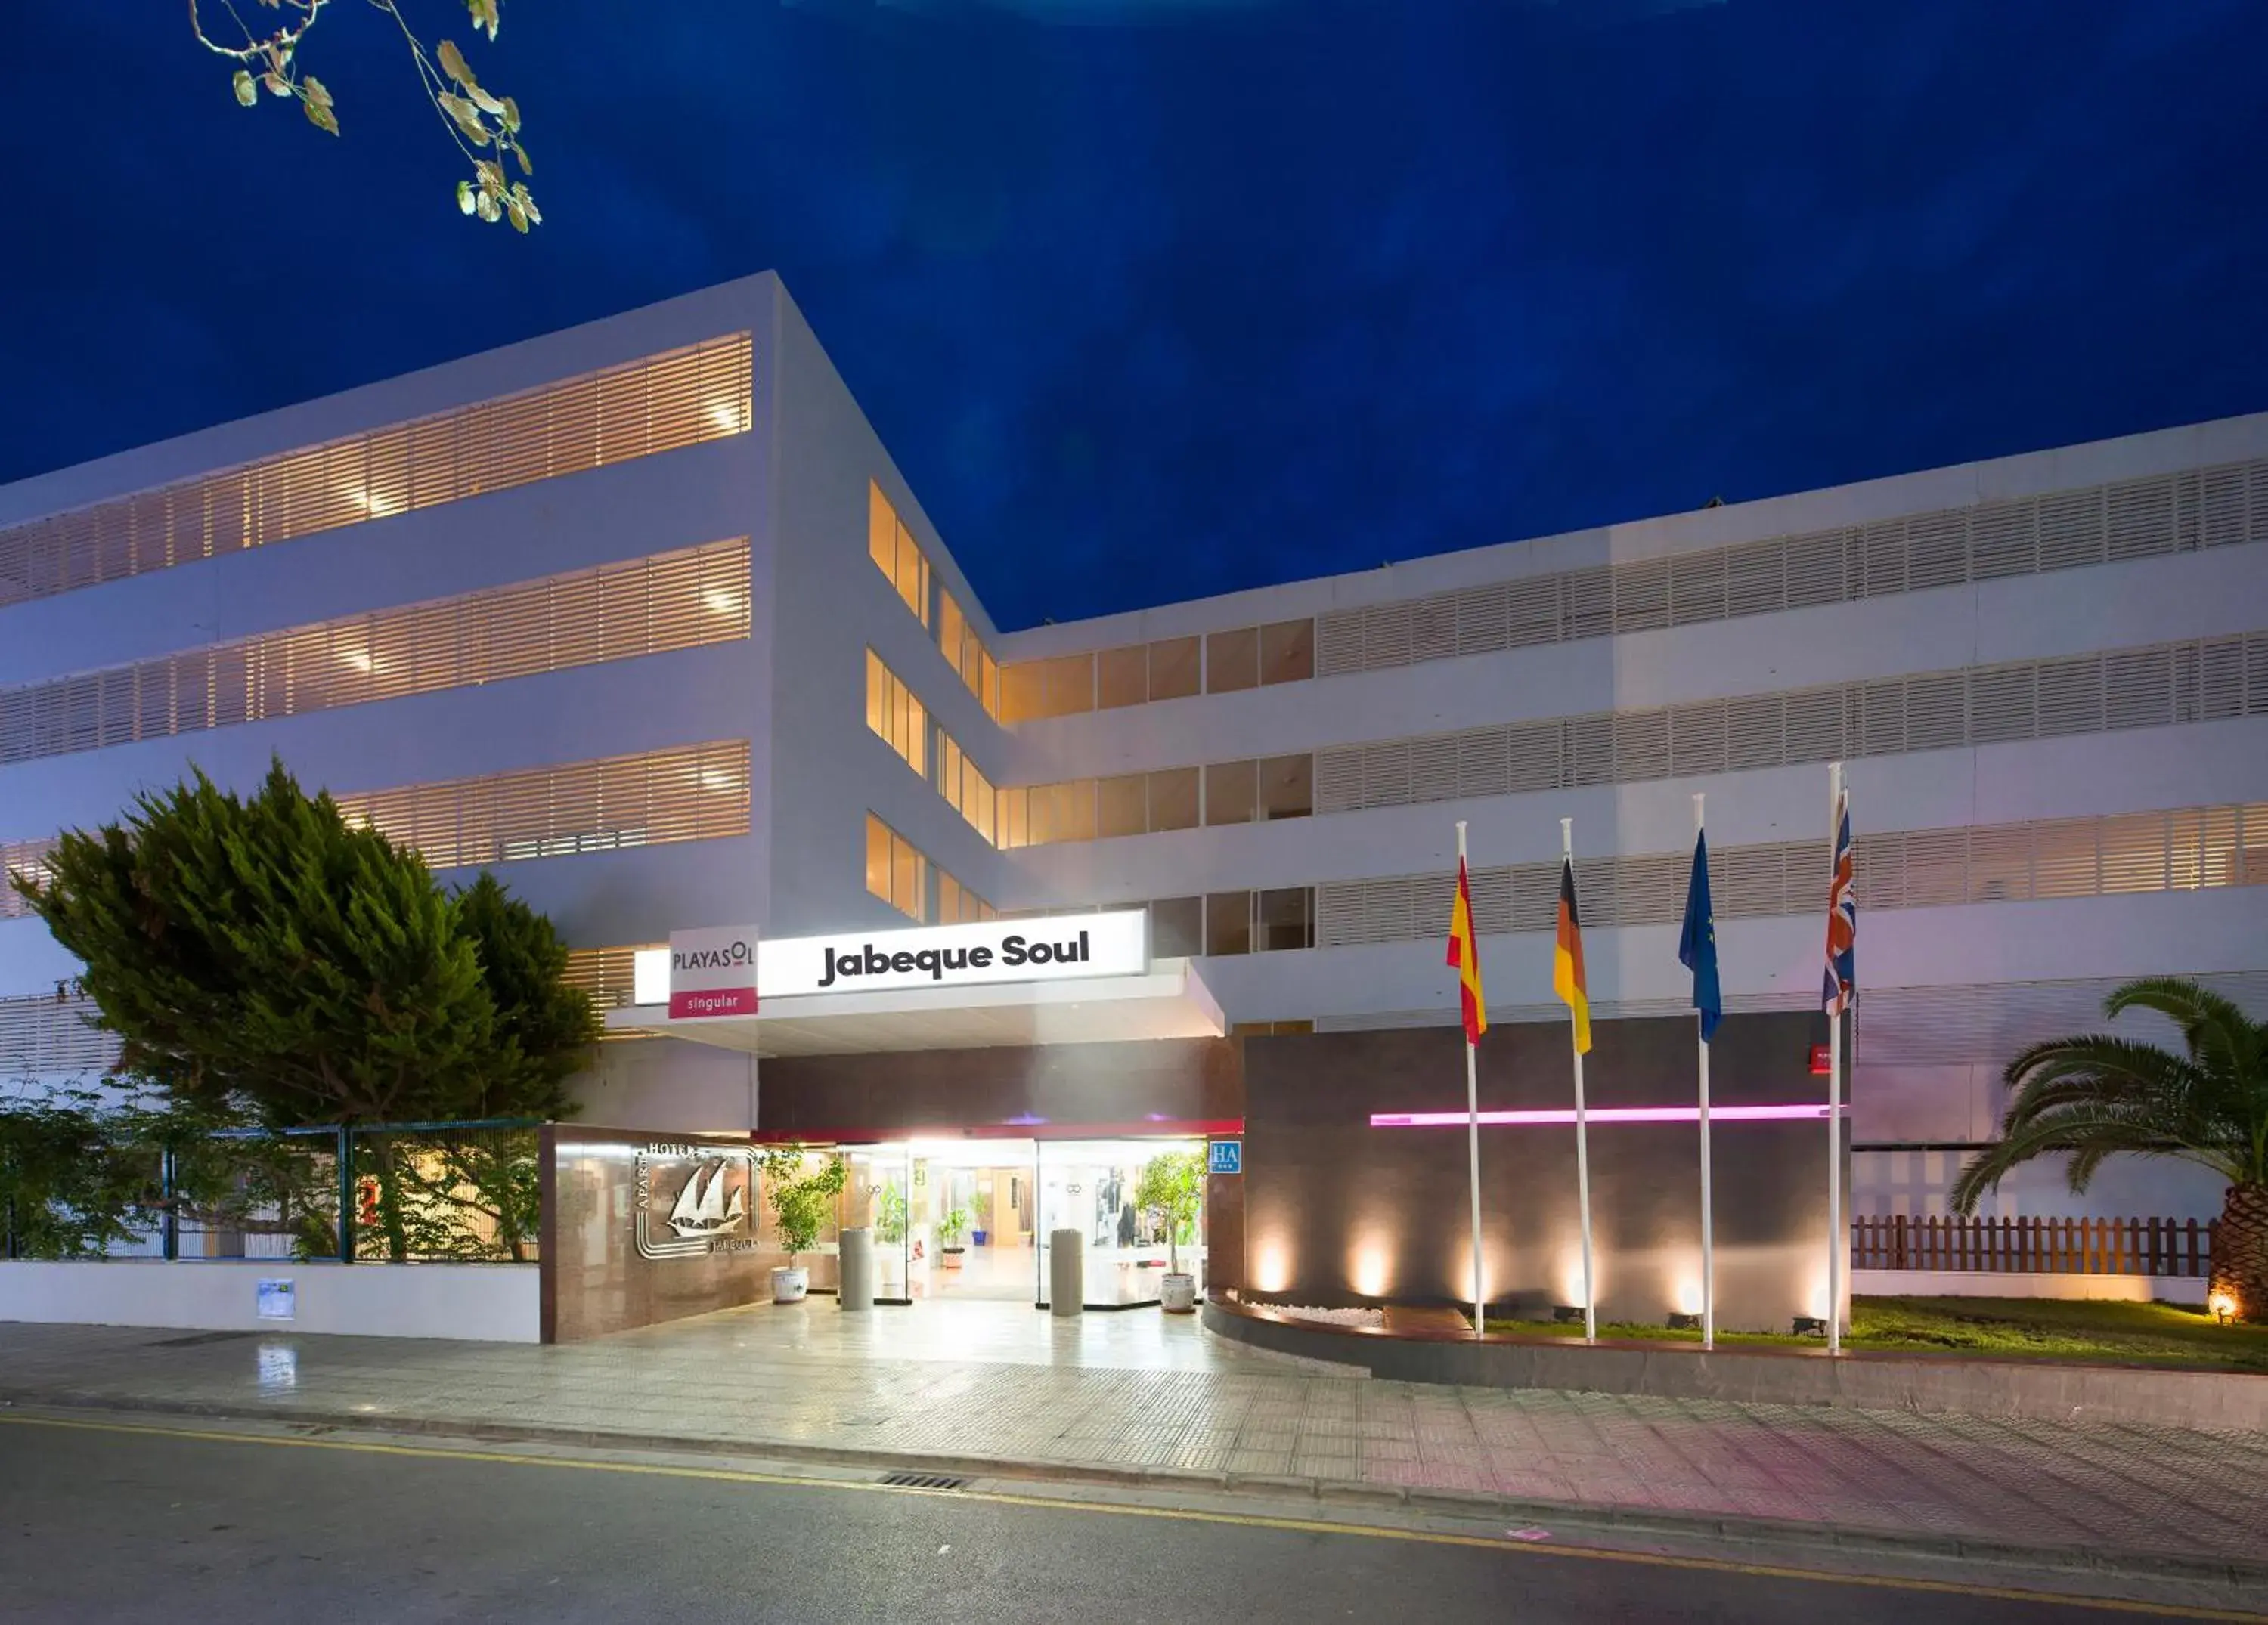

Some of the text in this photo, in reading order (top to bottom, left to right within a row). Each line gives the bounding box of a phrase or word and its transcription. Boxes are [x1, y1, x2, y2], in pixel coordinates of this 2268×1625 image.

[673, 941, 754, 970] PLAYASOL
[818, 930, 1089, 986] Jabeque Soul
[687, 994, 739, 1011] singular
[1212, 1145, 1238, 1163] HA
